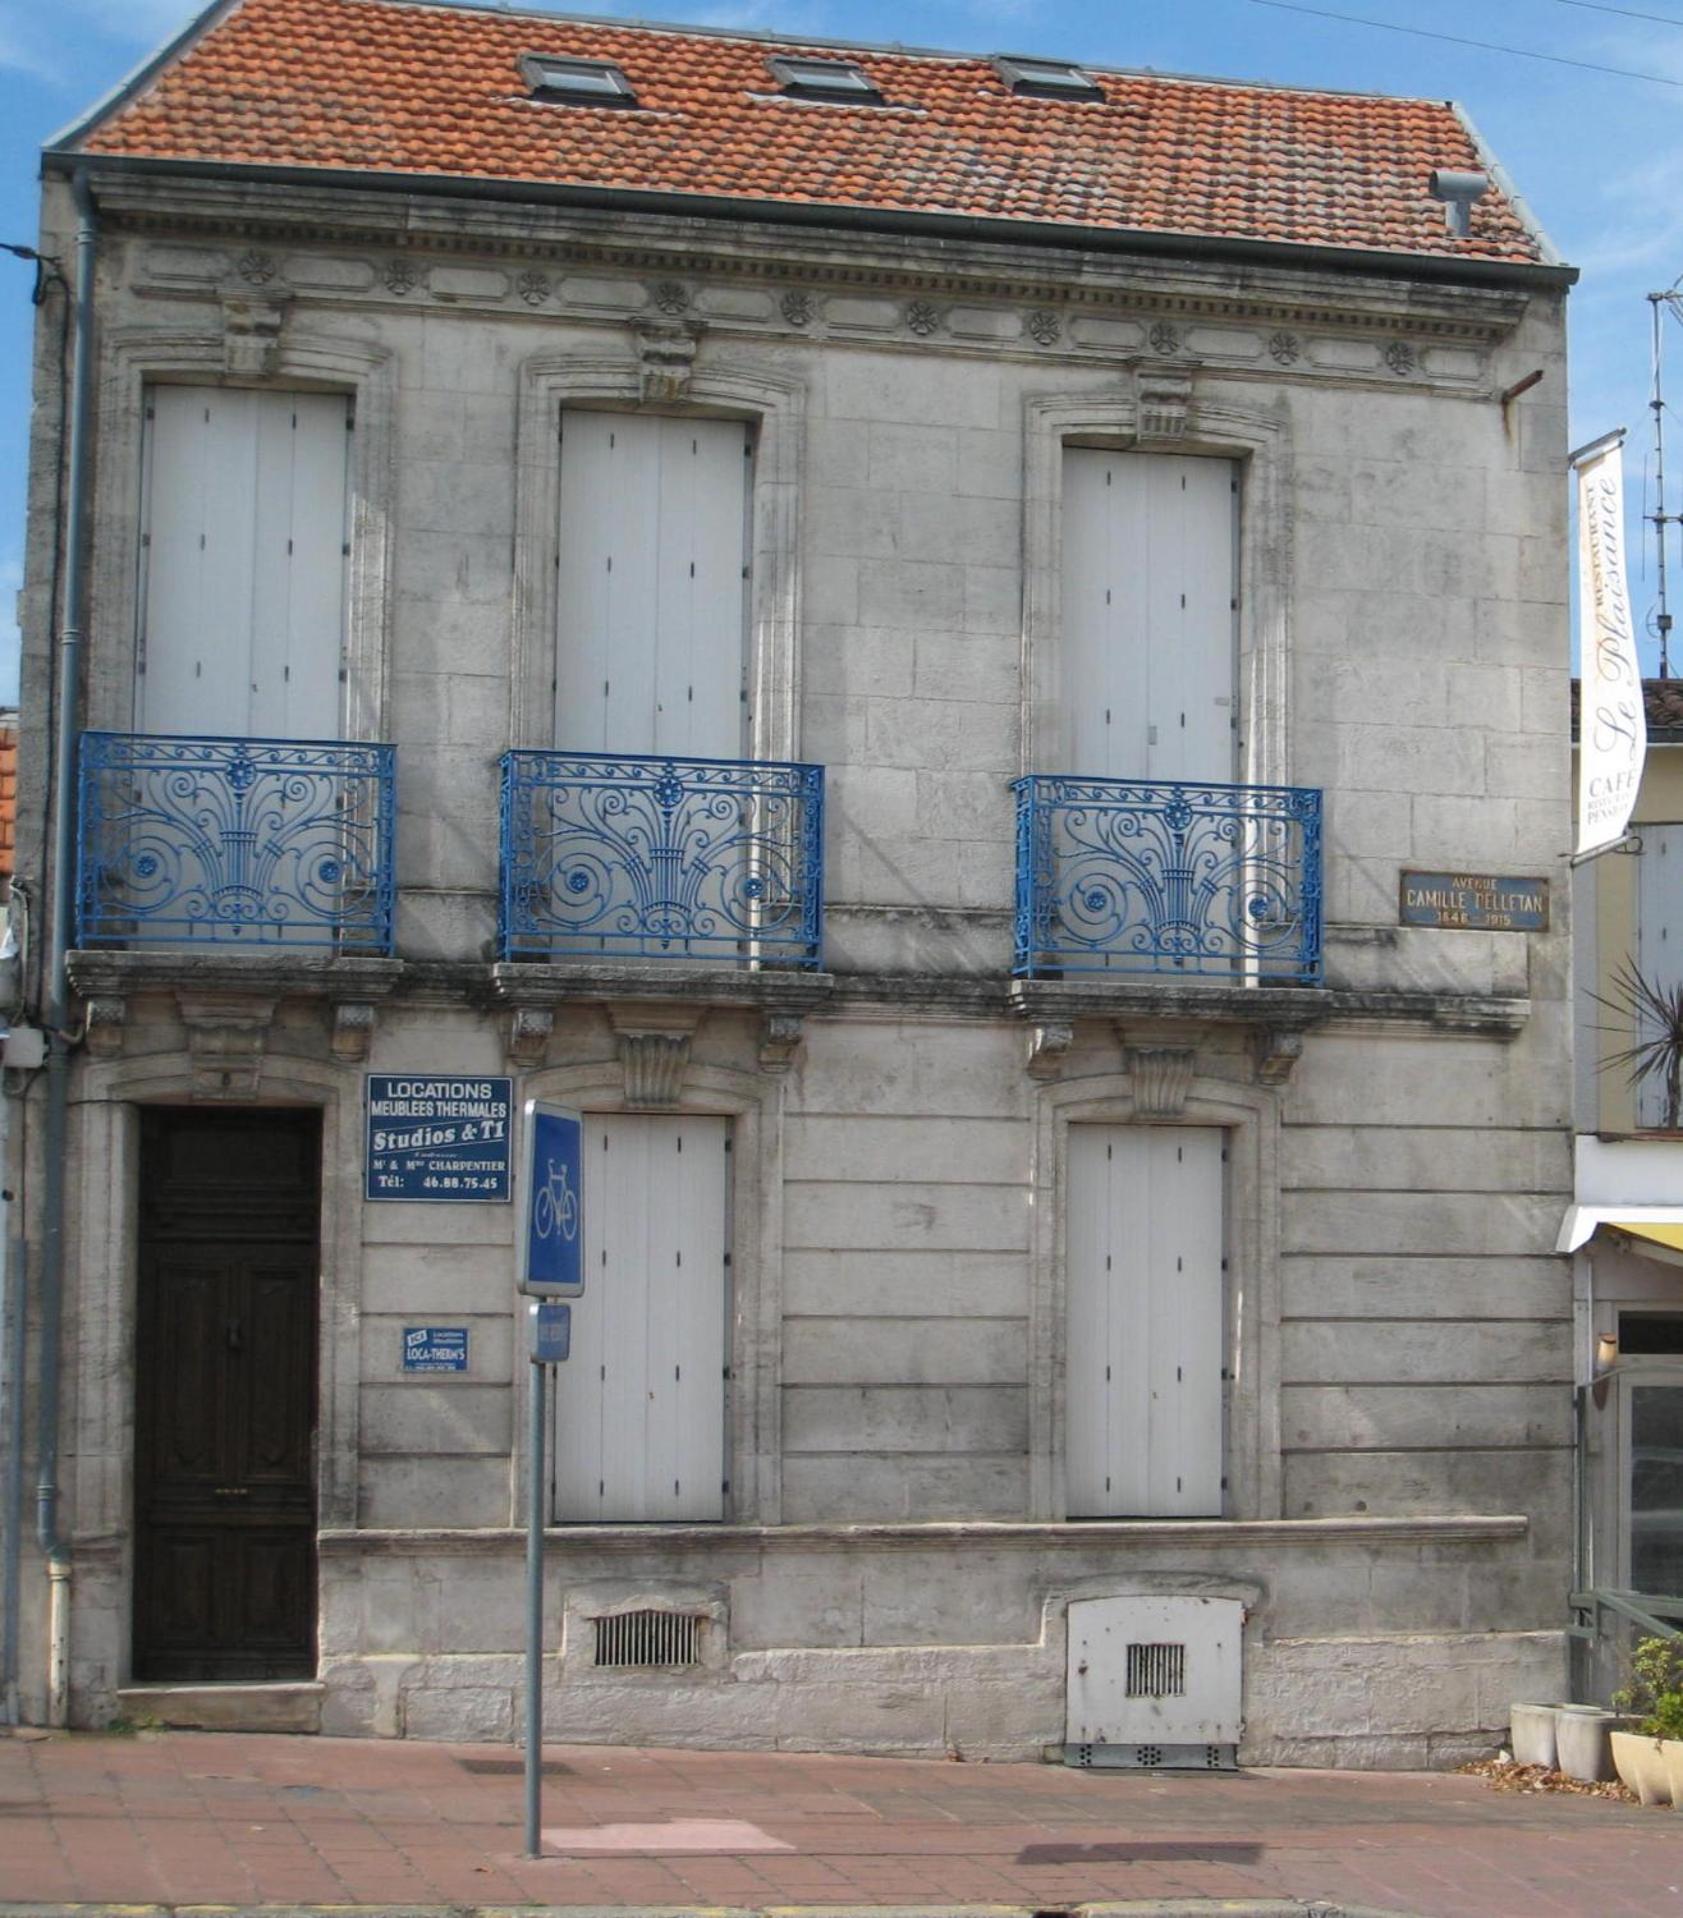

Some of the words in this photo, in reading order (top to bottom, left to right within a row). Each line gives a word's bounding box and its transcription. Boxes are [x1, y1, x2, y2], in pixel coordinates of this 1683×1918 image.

[1586, 486, 1603, 606] RESTAURANT
[1597, 478, 1634, 687] Plaisance
[1594, 701, 1637, 761] Le
[1452, 877, 1498, 890] AVENUE
[1407, 889, 1467, 909] CAMILLE
[1475, 892, 1542, 912] PELLETAN
[387, 1082, 492, 1099] LOCATIONS
[371, 1100, 434, 1117] MEUBLEES
[436, 1101, 507, 1118] THERMALES
[373, 1127, 455, 1151] Studios
[461, 1123, 478, 1141] &
[480, 1120, 505, 1139] T1
[389, 1160, 399, 1170] &
[428, 1160, 506, 1171] CHARPENTIER
[423, 1176, 498, 1189] 46.88.75.45
